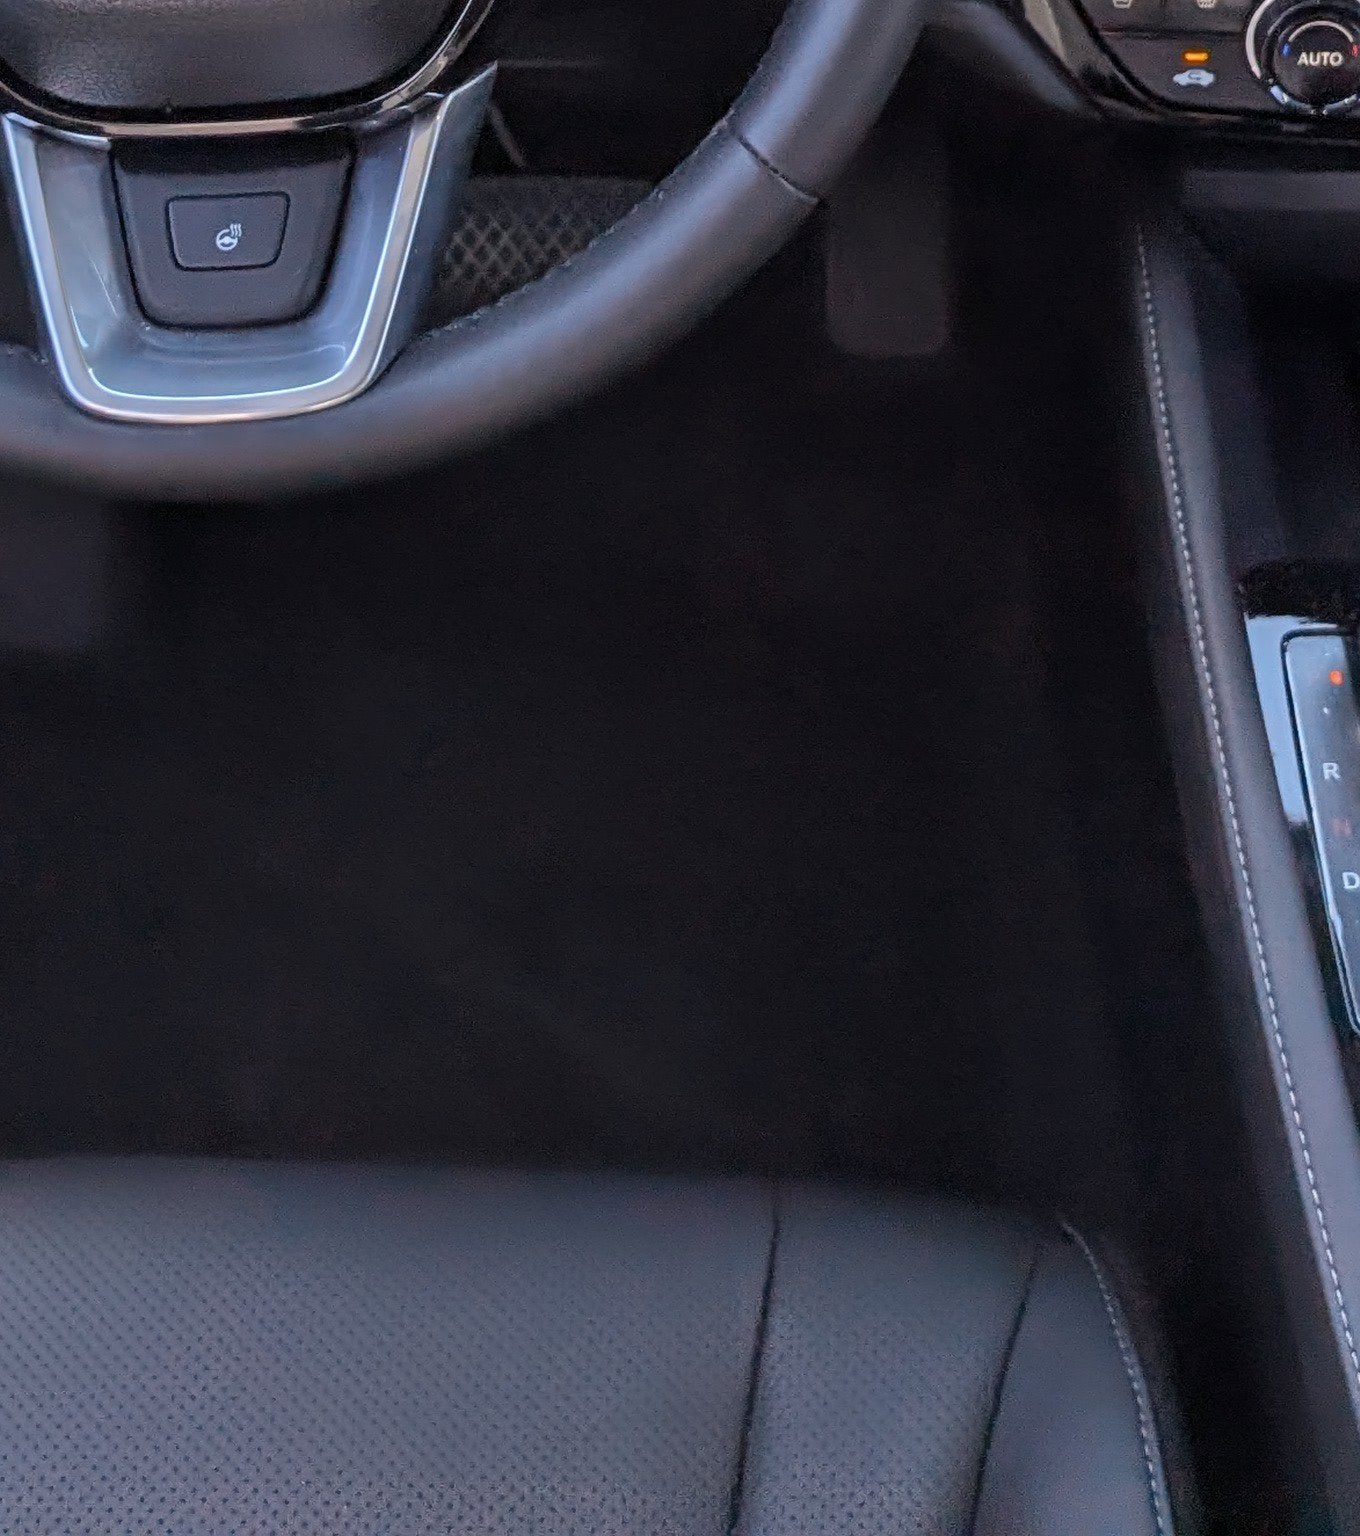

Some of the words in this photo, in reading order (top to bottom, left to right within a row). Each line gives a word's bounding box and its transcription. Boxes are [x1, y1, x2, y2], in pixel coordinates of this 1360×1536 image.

[1296, 51, 1343, 67] AUTO
[1322, 762, 1340, 780] R
[1341, 871, 1360, 890] D
